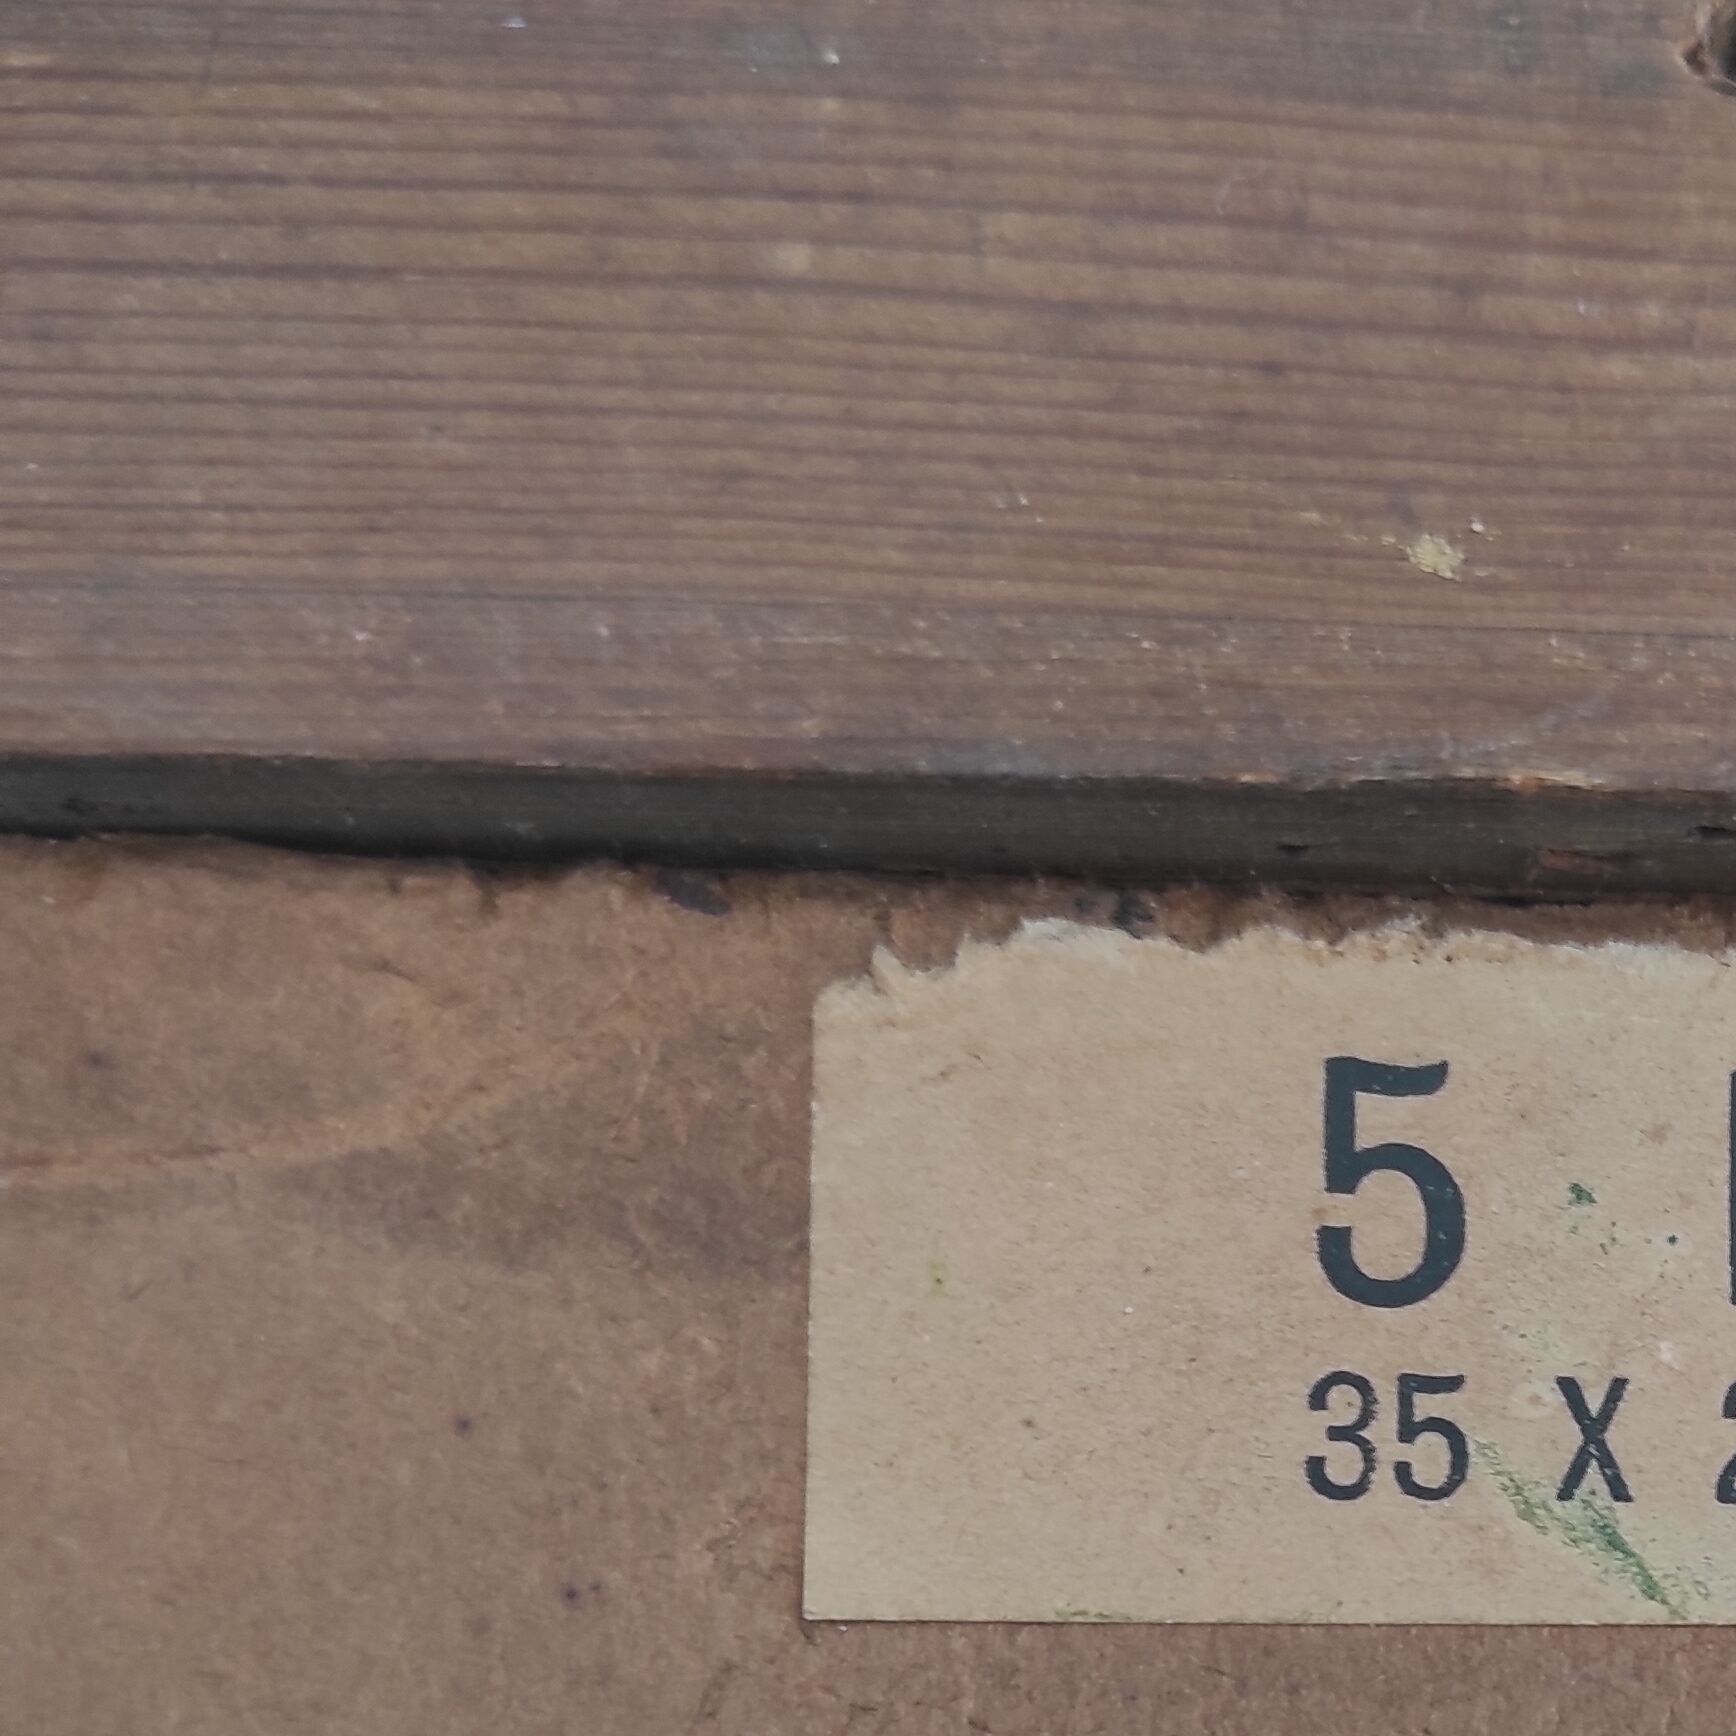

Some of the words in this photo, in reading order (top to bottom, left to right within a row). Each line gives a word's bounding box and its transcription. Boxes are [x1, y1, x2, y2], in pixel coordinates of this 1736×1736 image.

[1315, 1056, 1465, 1307] 5
[1305, 1370, 1469, 1501] 35
[1554, 1376, 1634, 1502] X
